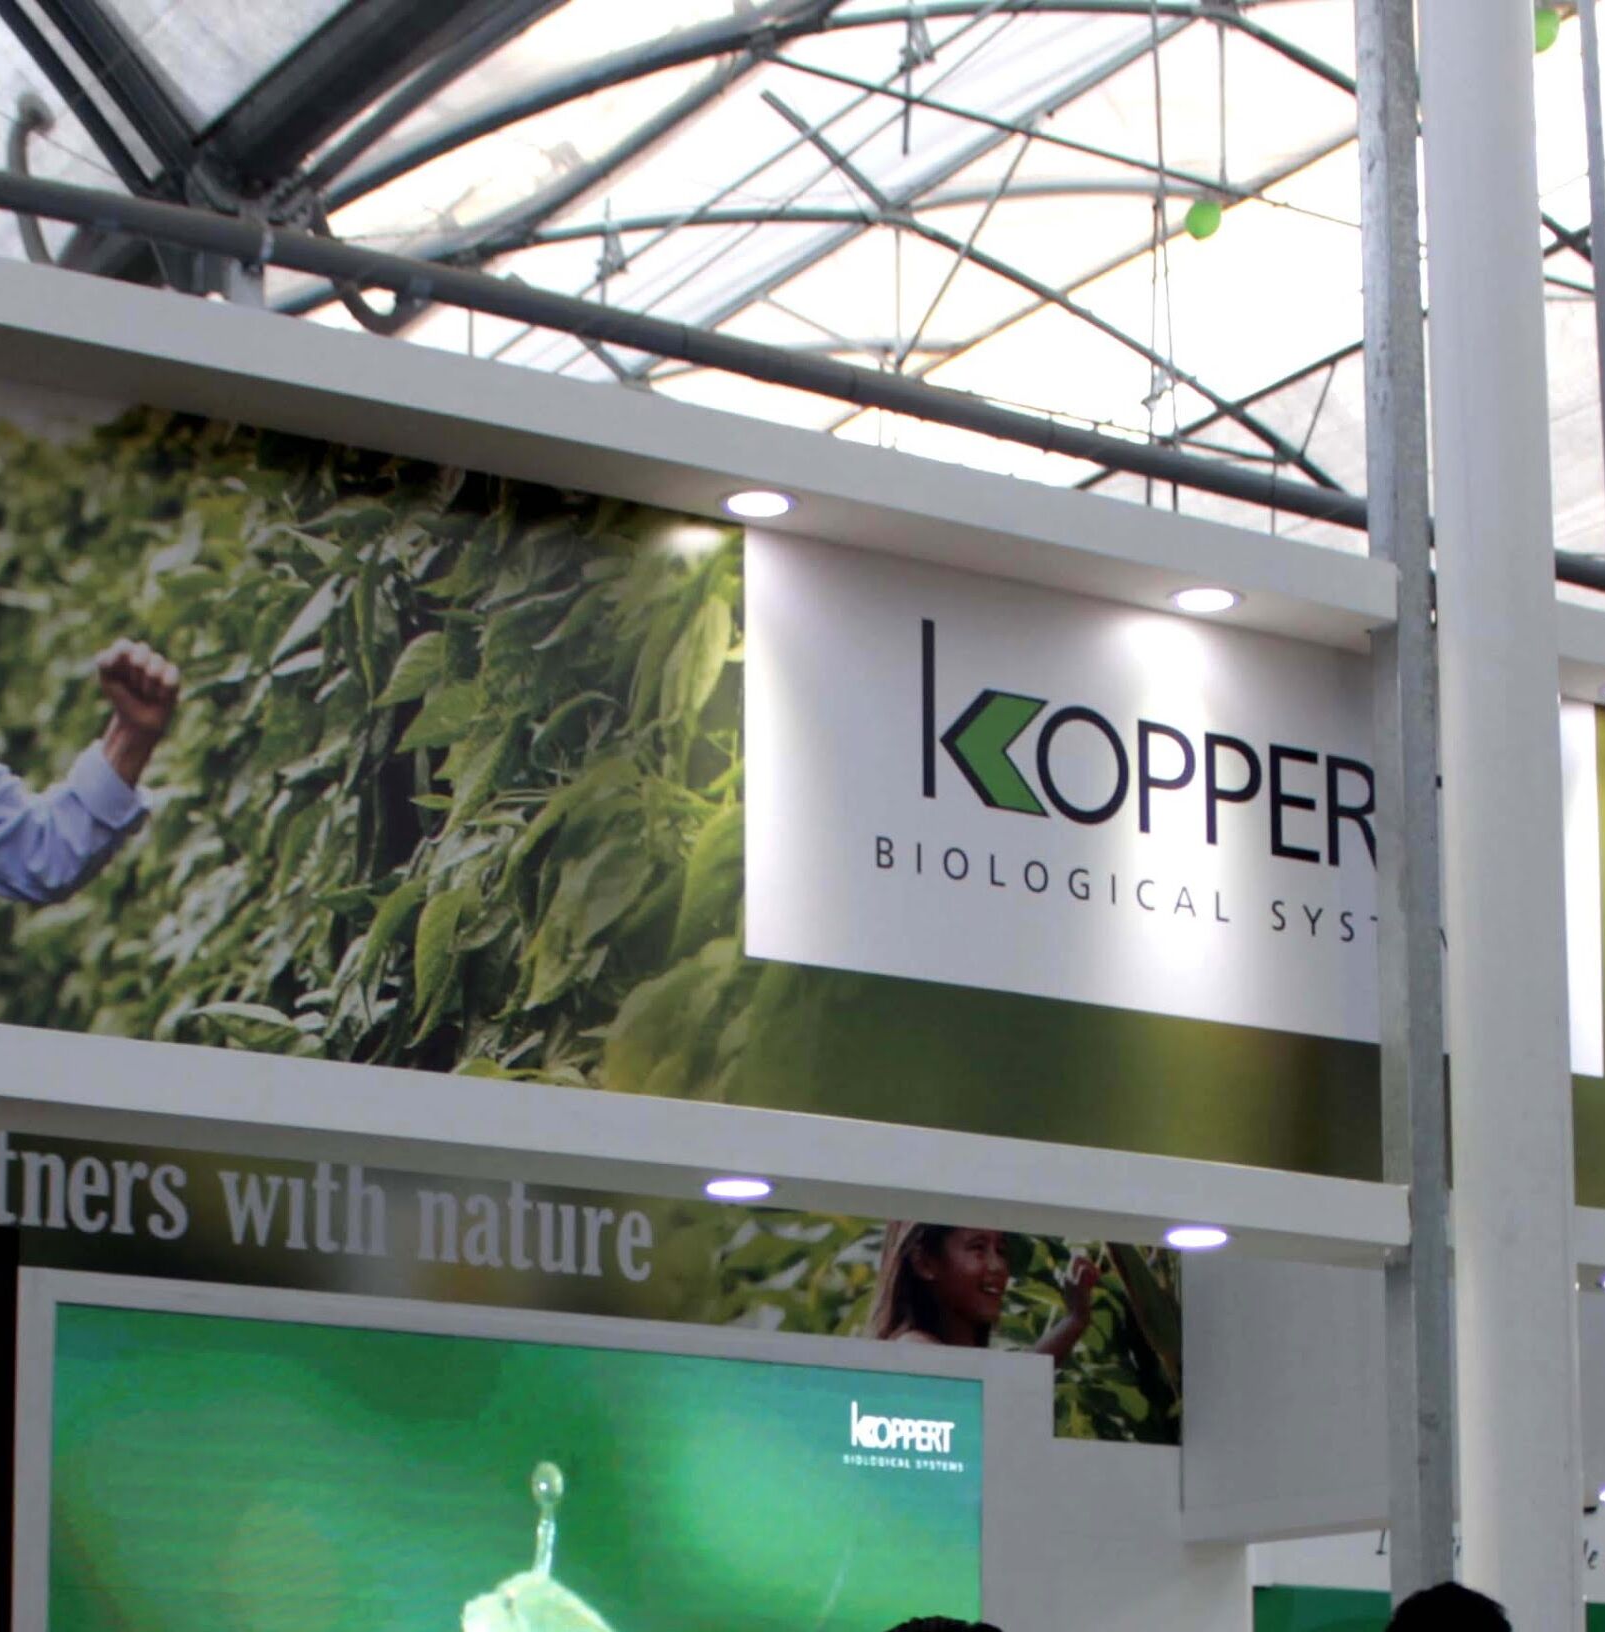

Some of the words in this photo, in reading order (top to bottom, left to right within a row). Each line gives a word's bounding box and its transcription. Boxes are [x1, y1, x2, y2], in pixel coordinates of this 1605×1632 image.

[875, 836, 1231, 923] BIOLOGICAL
[1271, 900, 1379, 943] SYS
[220, 1162, 388, 1257] with
[417, 1182, 653, 1283] nature
[842, 1454, 911, 1470] BIOLOGICAL
[915, 1459, 965, 1473] SYSTEMS
[851, 1400, 956, 1454] KOPPERT
